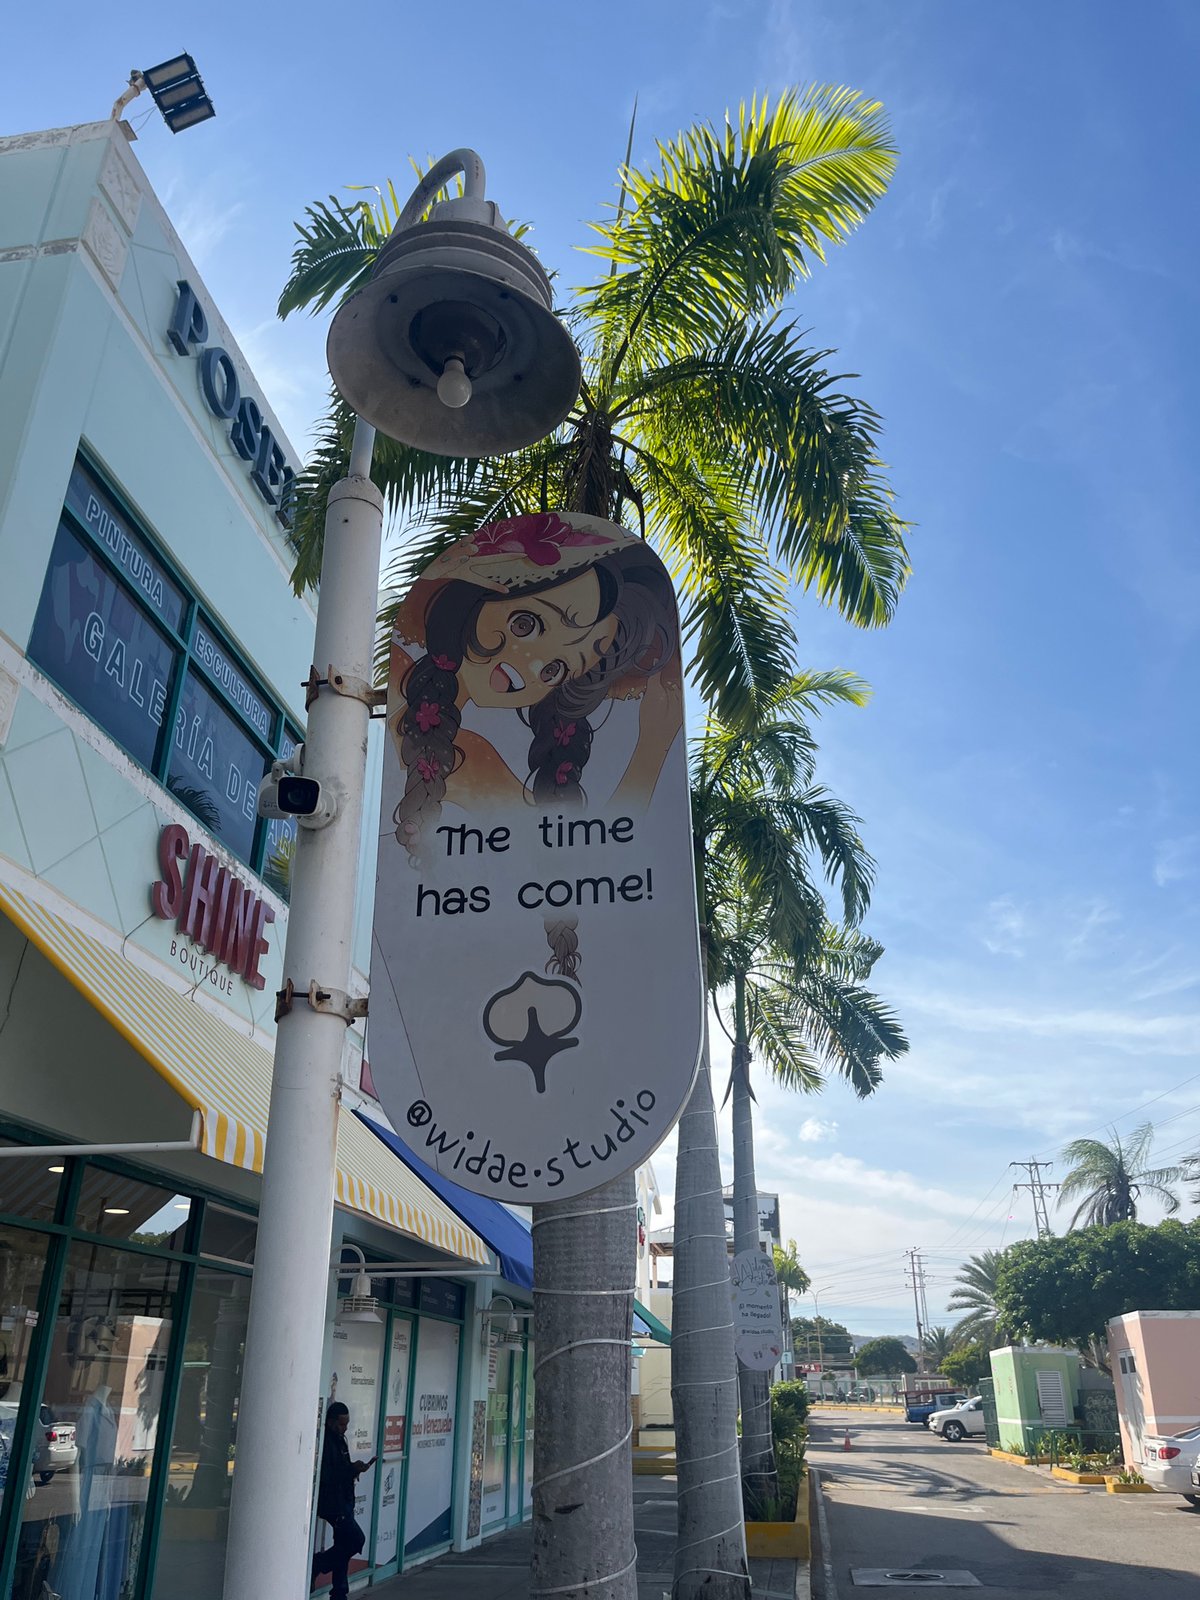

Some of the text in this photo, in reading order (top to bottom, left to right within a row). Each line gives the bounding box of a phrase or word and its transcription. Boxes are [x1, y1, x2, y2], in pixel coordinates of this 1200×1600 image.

[85, 494, 163, 606] PINTURA
[194, 630, 268, 735] ESCULTURA
[83, 611, 214, 780] GALERÍA
[226, 763, 256, 822] DE
[436, 814, 634, 856] The time
[152, 823, 275, 991] SHINE
[416, 867, 653, 917] has come!
[170, 939, 234, 997] BOUTIQUE
[419, 1394, 448, 1411] CUBRIMOS
[423, 1413, 452, 1434] Venezuela
